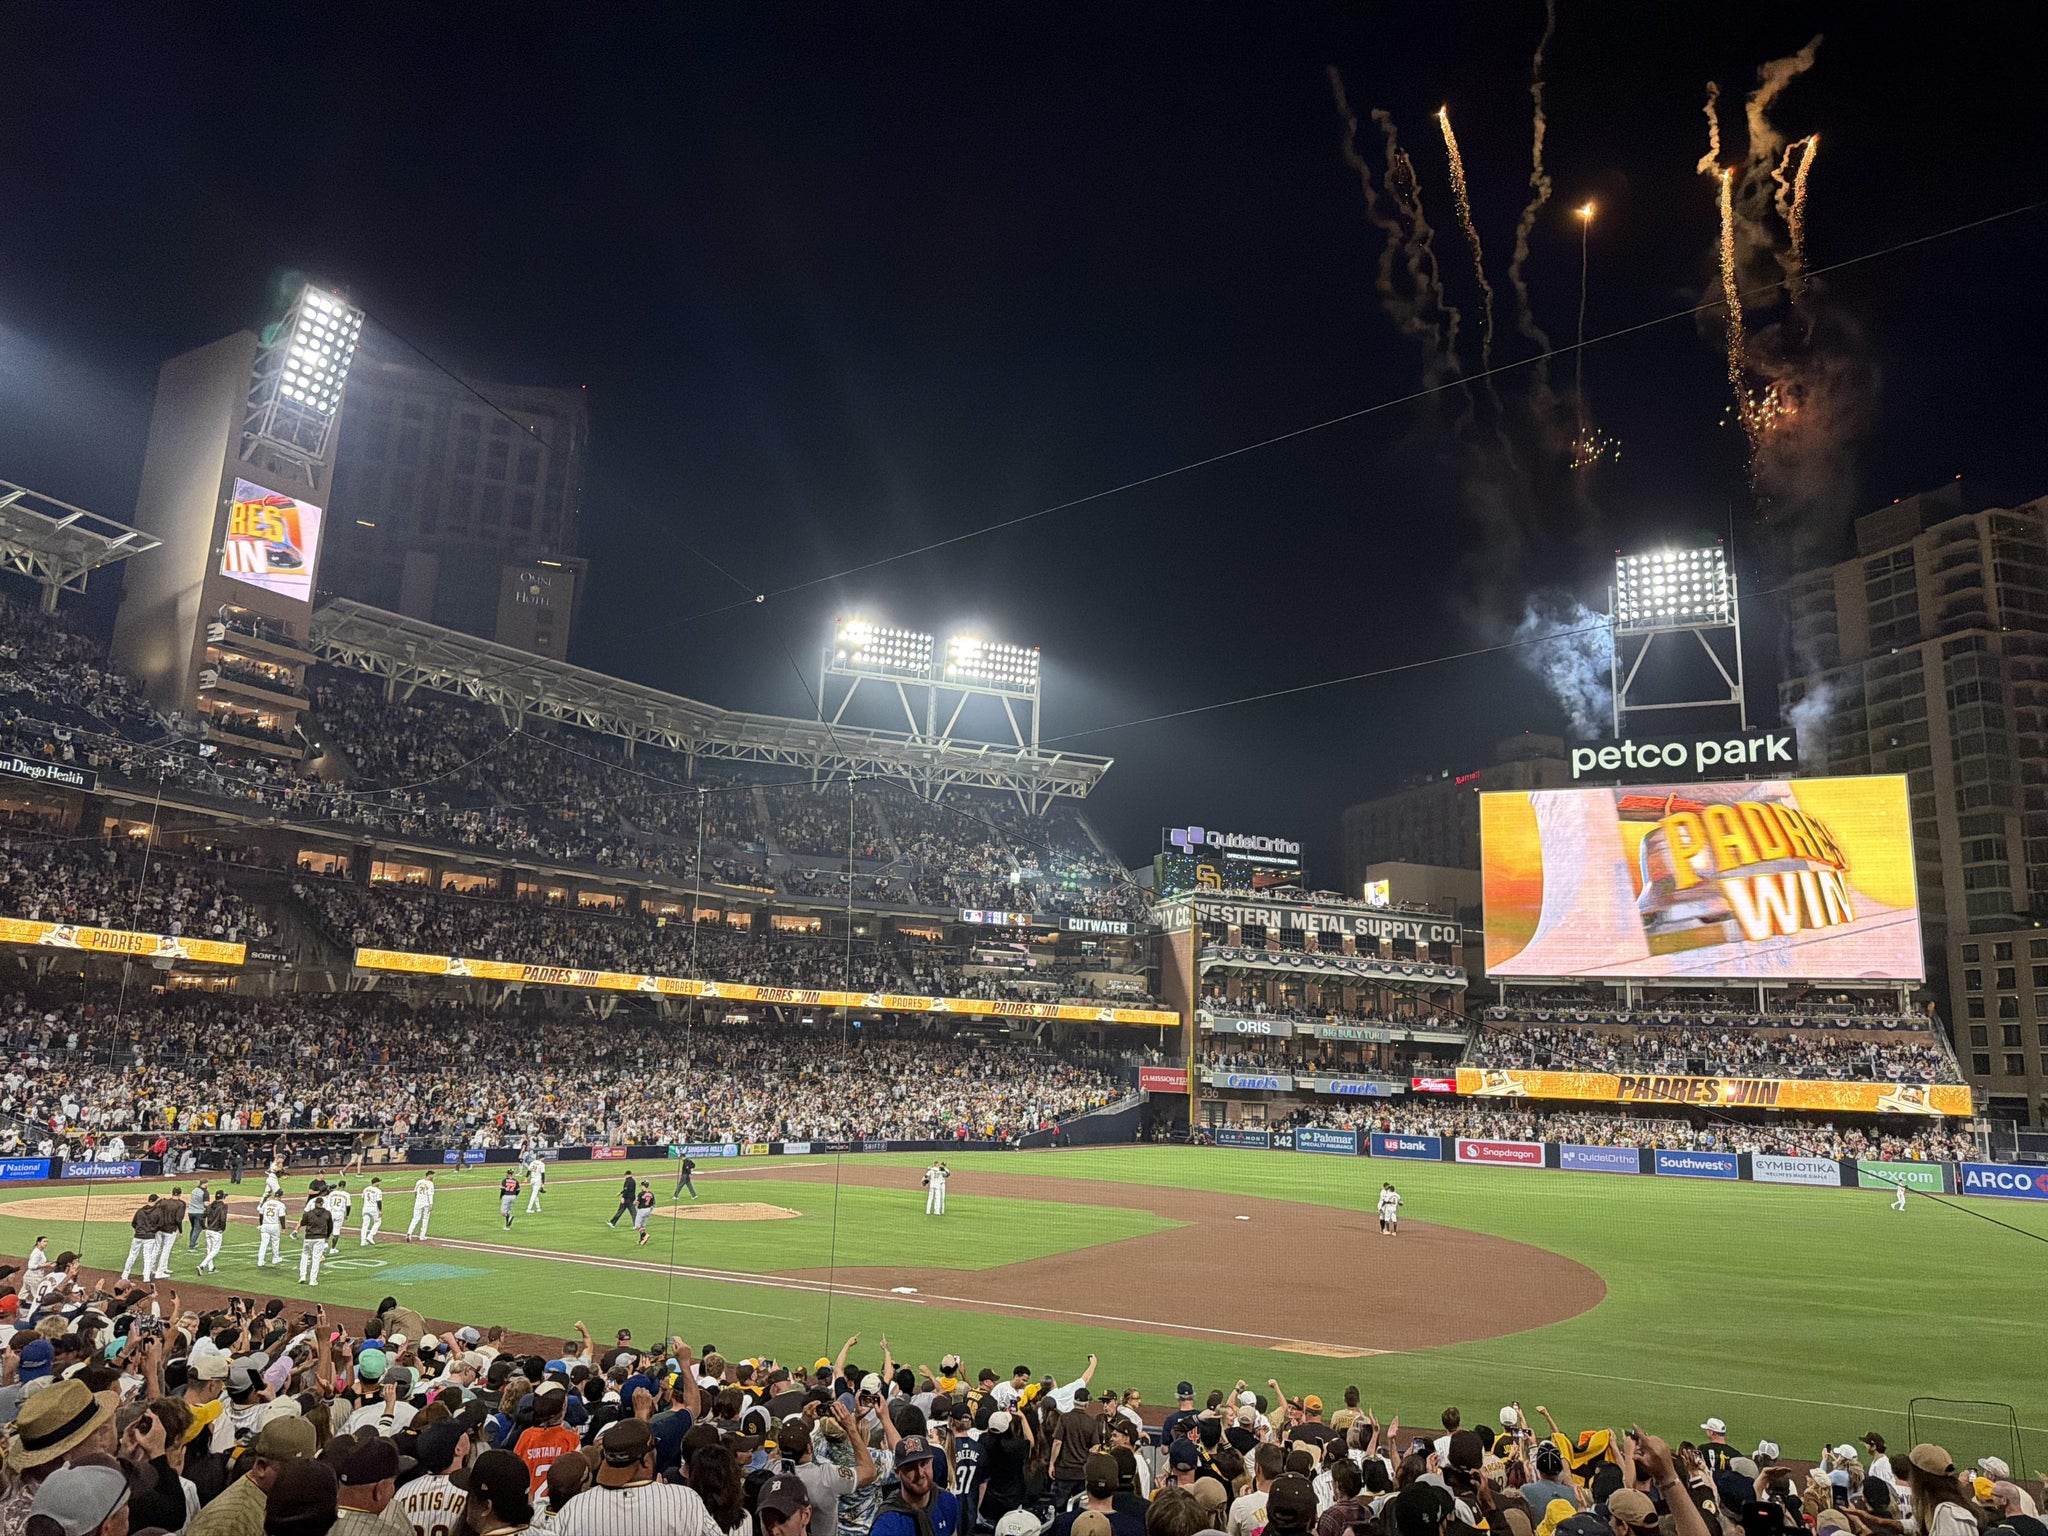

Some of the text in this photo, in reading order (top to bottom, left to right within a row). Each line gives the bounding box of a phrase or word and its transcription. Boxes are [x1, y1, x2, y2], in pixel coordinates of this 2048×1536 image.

[231, 503, 285, 543] RES
[226, 540, 267, 574] IN
[1571, 734, 1793, 779] petco park
[12, 758, 46, 779] Diego
[46, 765, 84, 785] Health
[1206, 830, 1300, 855] QuidelOrtho
[1718, 869, 1854, 942] WIN
[1068, 918, 1128, 934] CUTWATER
[1194, 902, 1460, 944] WESTERN METAL SUPPLY CO.
[93, 931, 143, 951] PADRES
[250, 951, 278, 960] SONY
[521, 965, 572, 983] PADRES
[664, 979, 694, 993] PADRES
[755, 987, 795, 1001] PADRES
[891, 996, 923, 1008] PADRES
[992, 1001, 1036, 1016] PADRES
[1235, 1020, 1271, 1034] ORIS
[1322, 1027, 1338, 1038] BIG
[1338, 1029, 1362, 1039] BULLY
[1201, 1086, 1219, 1098] 336
[1616, 1076, 1780, 1104] PADRES WIN
[1273, 1135, 1293, 1148] 342
[1312, 1132, 1354, 1145] Palomar
[1399, 1140, 1426, 1151] bank
[1482, 1147, 1535, 1160] Snapdragon
[1578, 1152, 1635, 1165] QuidelOrtho
[6, 1163, 41, 1172] National
[68, 1164, 127, 1176] Southwest
[1660, 1156, 1724, 1171] Southwest
[1756, 1160, 1835, 1173] CYMBIOTIKA
[1965, 1170, 2032, 1191] ARCO
[333, 1198, 342, 1207] 12
[266, 1208, 276, 1218] 25
[401, 1492, 465, 1514] TATIS JR
